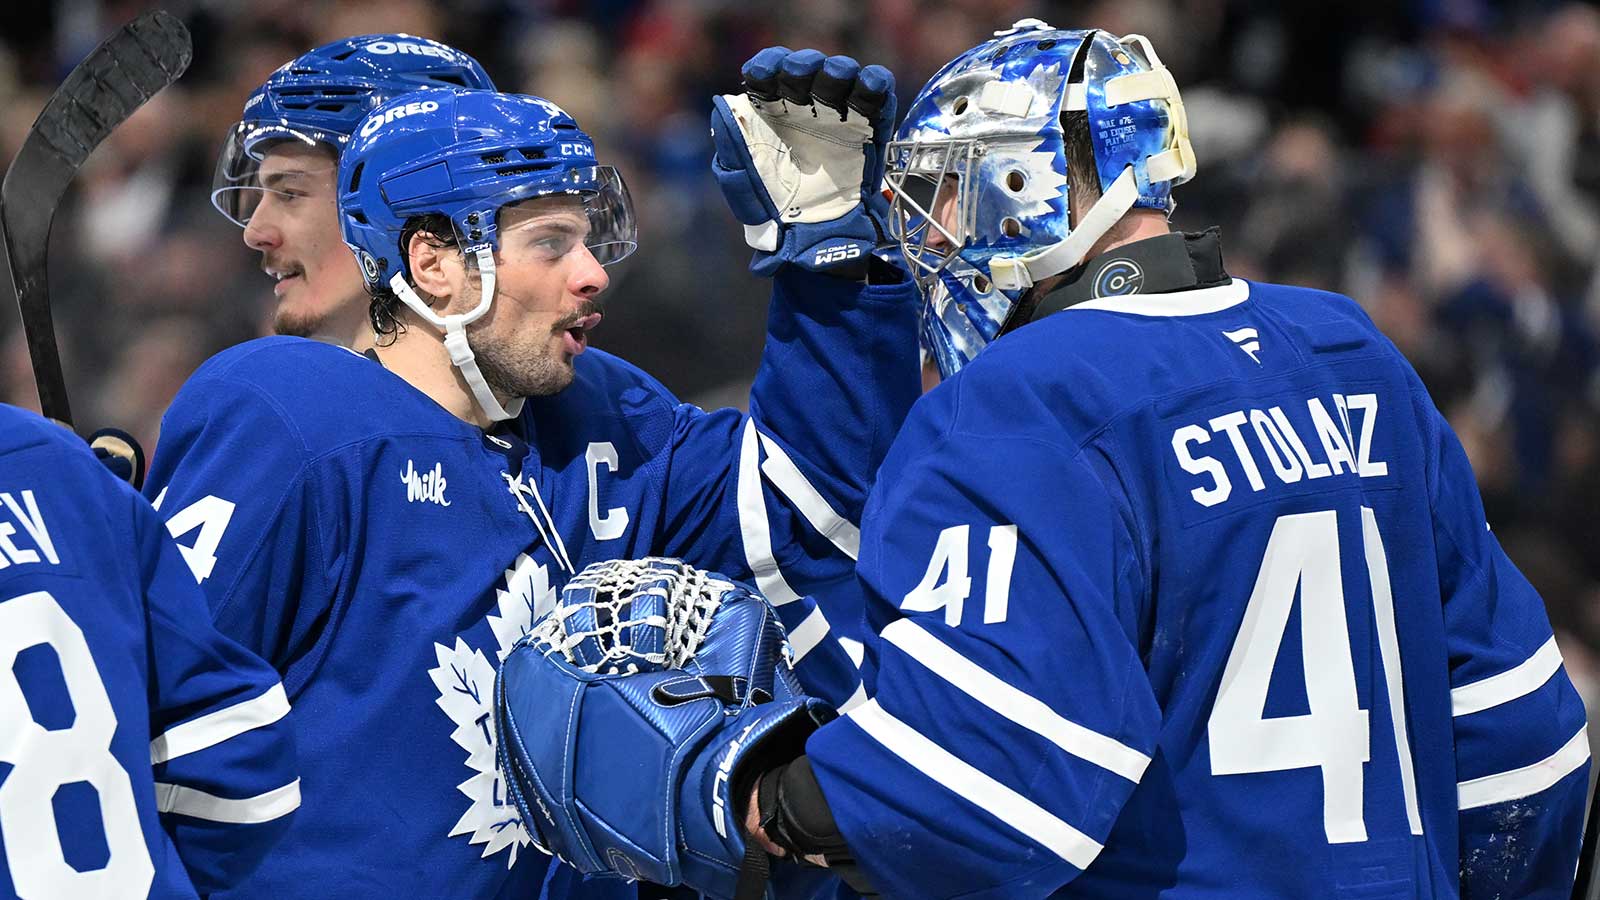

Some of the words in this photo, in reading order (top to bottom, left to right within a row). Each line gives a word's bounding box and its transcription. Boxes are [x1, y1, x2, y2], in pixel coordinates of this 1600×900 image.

[366, 41, 456, 62] OREO
[360, 101, 439, 138] OREO
[561, 143, 593, 157] CCM
[464, 242, 489, 254] CCM
[815, 248, 860, 265] CCM
[400, 459, 451, 507] Milk
[585, 441, 630, 540] C
[0, 490, 61, 569] EV
[152, 486, 236, 584] 4
[900, 524, 1018, 628] 41
[1207, 505, 1423, 844] 41
[0, 590, 156, 900] 8
